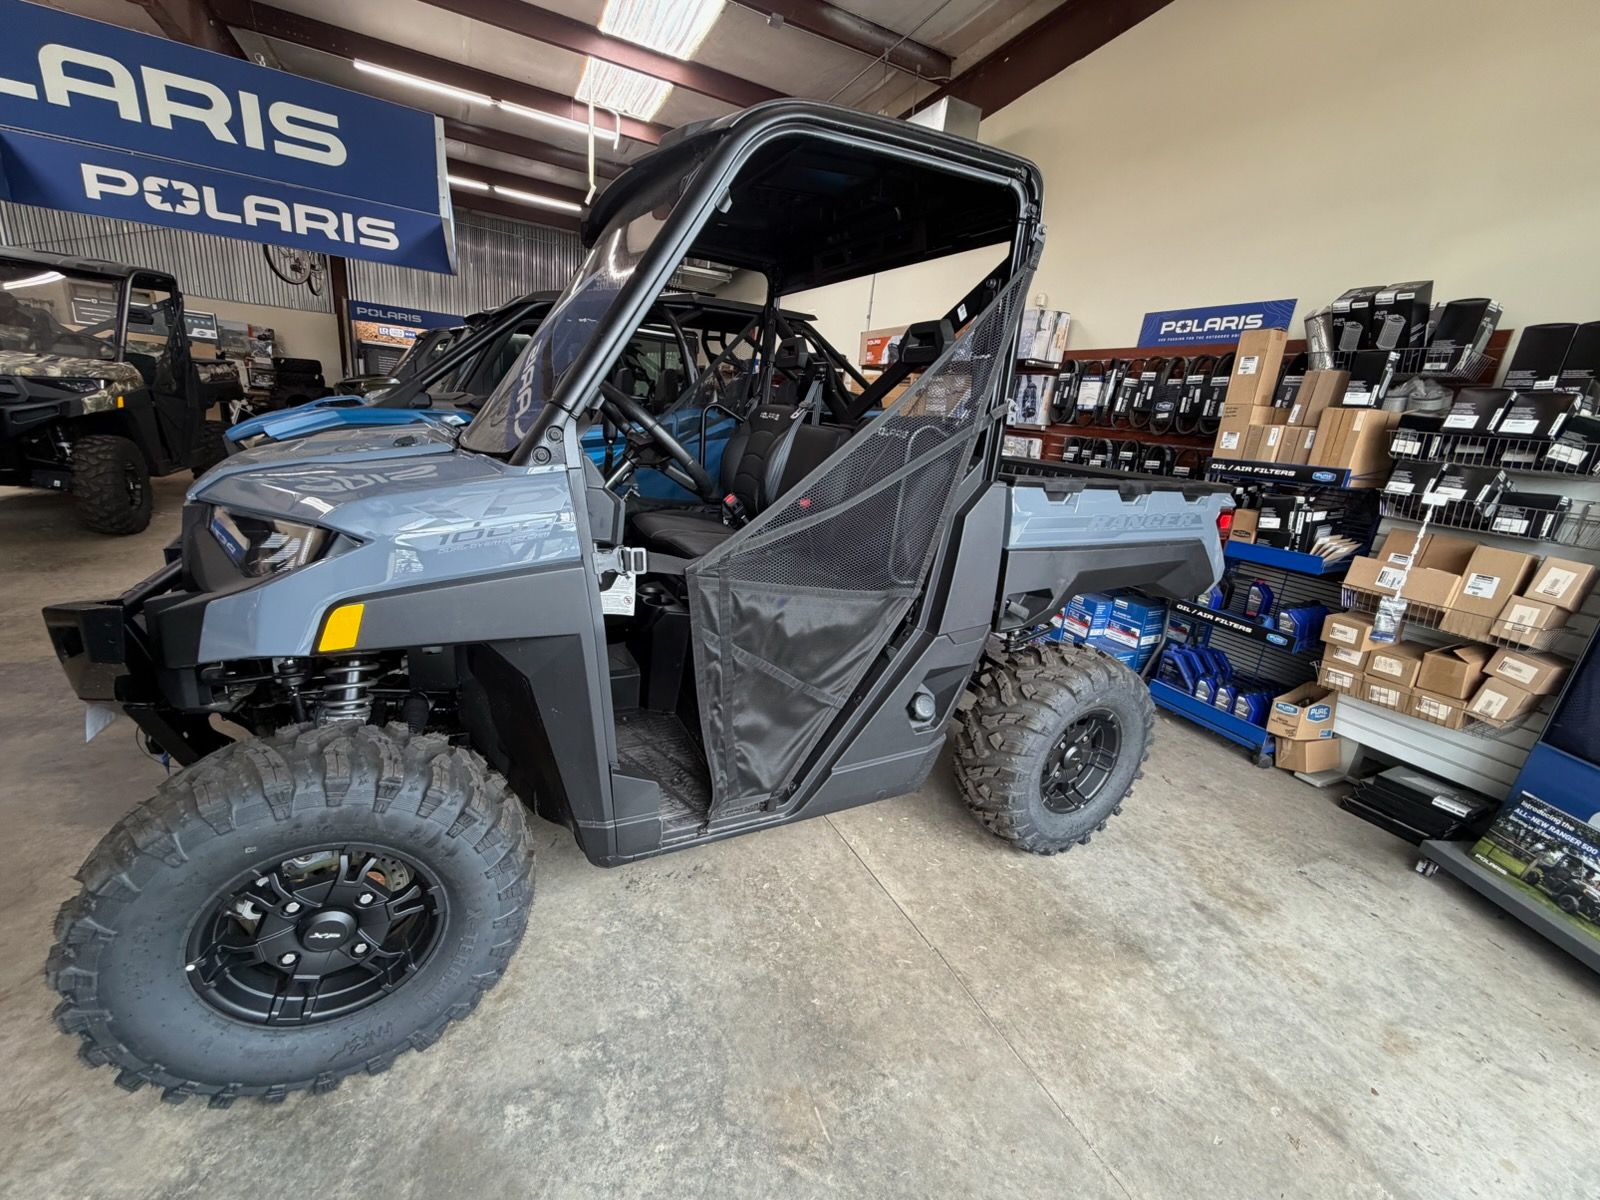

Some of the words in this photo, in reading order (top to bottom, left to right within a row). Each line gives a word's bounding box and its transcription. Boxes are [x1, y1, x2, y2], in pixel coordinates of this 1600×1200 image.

[80, 163, 400, 251] POLARIS
[356, 306, 422, 323] POLARIS
[1160, 314, 1264, 335] POLARIS
[1254, 467, 1296, 477] FILTERS
[1087, 512, 1197, 531] RANGER
[1176, 604, 1191, 613] OIL
[1197, 611, 1214, 620] AIR
[1214, 616, 1253, 633] FILTERS
[1310, 707, 1328, 715] PURE
[1514, 808, 1550, 829] ALL-NEW
[1548, 825, 1582, 847] RANGER
[1581, 843, 1599, 855] 500
[1561, 821, 1575, 832] the
[1475, 853, 1508, 875] POLARIS
